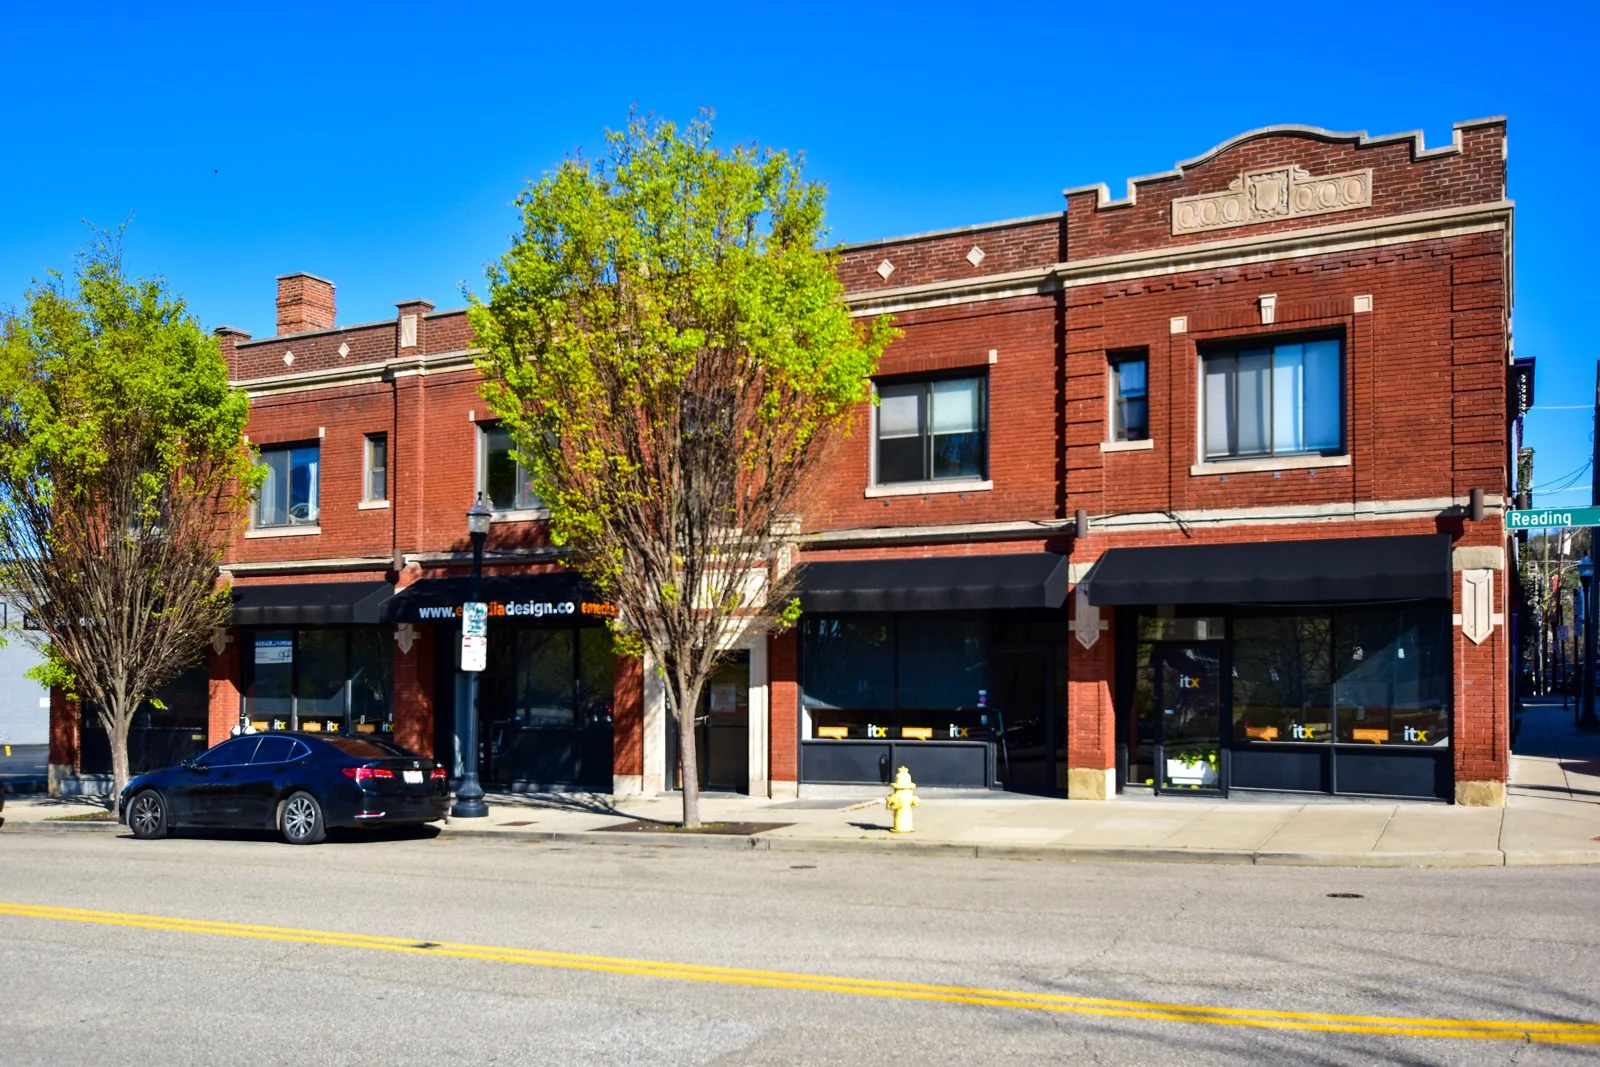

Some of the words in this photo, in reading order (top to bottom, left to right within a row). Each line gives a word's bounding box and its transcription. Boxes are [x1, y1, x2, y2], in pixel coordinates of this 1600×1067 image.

[1511, 511, 1572, 526] Reading
[419, 600, 576, 619] www.ediadesign.co
[1179, 674, 1201, 689] itx
[274, 719, 286, 731] itx
[327, 720, 339, 732] itx
[867, 723, 888, 738] itx
[949, 723, 969, 738] itx
[1292, 723, 1315, 740] itx
[1403, 726, 1428, 743] itx
